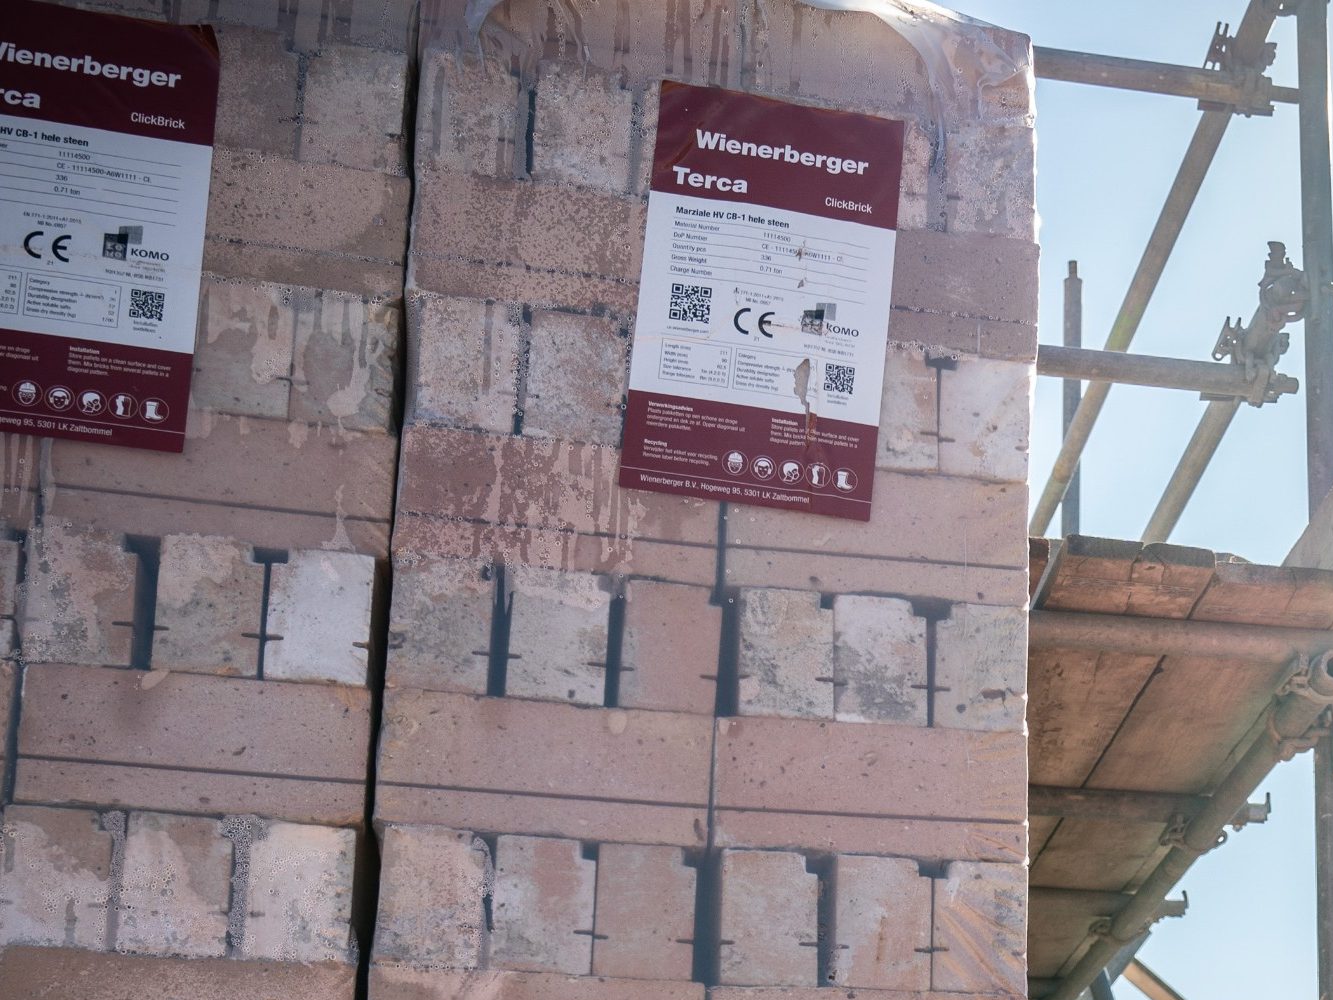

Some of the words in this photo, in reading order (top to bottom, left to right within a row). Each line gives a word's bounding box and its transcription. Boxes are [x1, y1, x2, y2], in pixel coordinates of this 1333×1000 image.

[130, 112, 185, 130] ClickBrick
[0, 126, 13, 135] HV
[16, 128, 38, 139] CB-1
[41, 131, 61, 142] hele
[64, 135, 89, 147] steen
[59, 150, 90, 161] 11114500
[695, 128, 869, 176] Wienerberger
[56, 162, 66, 170] CE
[672, 165, 748, 194] Terca
[69, 187, 81, 196] ton
[824, 196, 873, 215] ClickBrick
[675, 206, 711, 218] Marziale
[713, 210, 725, 219] HV
[726, 212, 746, 221] CB-1
[748, 215, 765, 225] hele
[767, 218, 790, 229] steen
[674, 220, 697, 229] Material
[698, 223, 720, 232] Number
[686, 233, 708, 241] Number
[131, 247, 170, 261] KOMO
[672, 242, 695, 252] Quantity
[671, 253, 687, 261] Gross
[688, 255, 707, 264] Weight
[670, 264, 690, 274] Charge
[691, 267, 713, 276] Number
[773, 266, 783, 275] ton
[826, 322, 860, 338] KOMO
[0, 416, 21, 425] eweg
[37, 420, 55, 429] 5301
[58, 422, 68, 431] LK
[69, 423, 113, 436] Zaltbommel
[640, 473, 684, 488] Wienerberger
[700, 482, 731, 495] Hogeweg
[744, 488, 761, 498] 5301
[762, 490, 771, 500] LK
[772, 491, 810, 504] Zaltbommel
